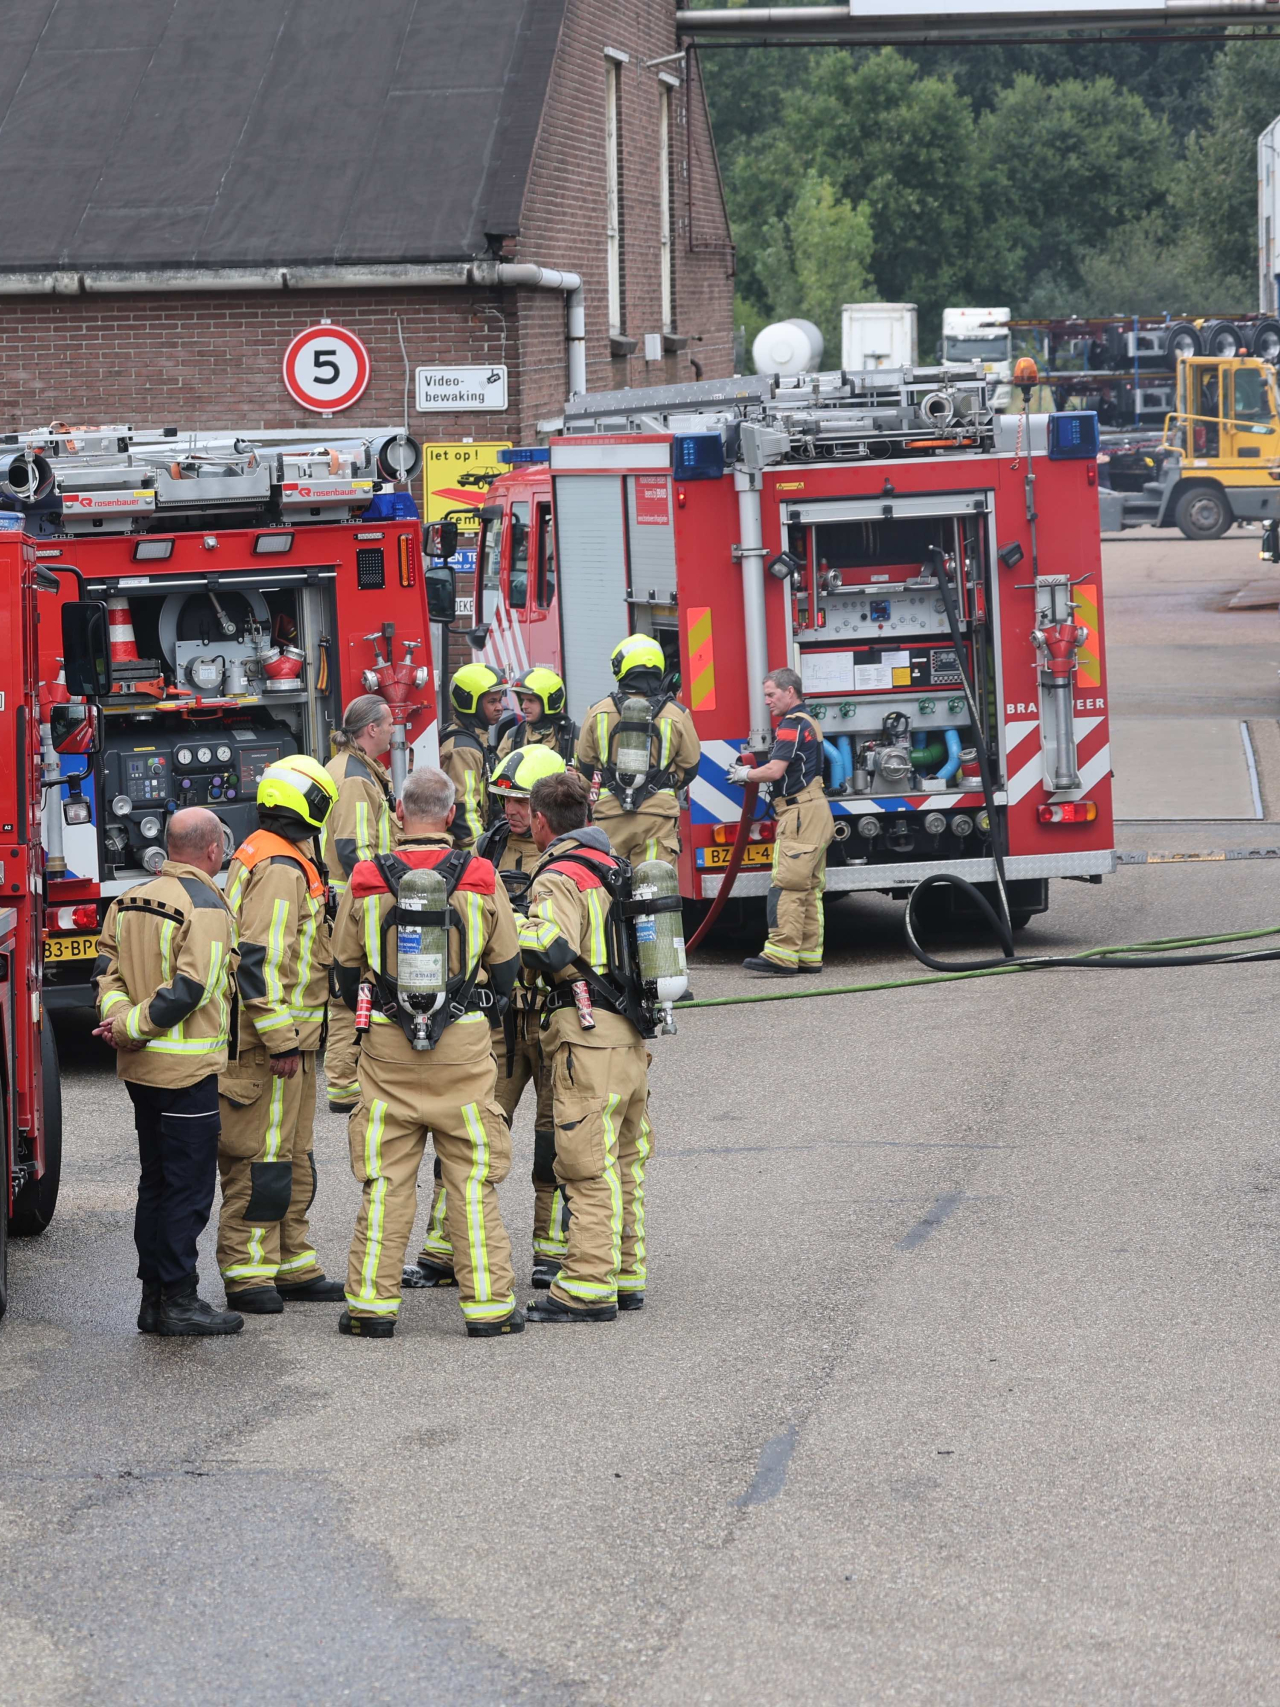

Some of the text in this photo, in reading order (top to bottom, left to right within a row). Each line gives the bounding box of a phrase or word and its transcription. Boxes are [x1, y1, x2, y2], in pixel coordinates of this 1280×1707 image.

[313, 349, 340, 385] 5
[424, 375, 465, 387] Video-
[424, 390, 485, 404] bewaking
[430, 450, 449, 461] let
[313, 488, 358, 497] rosenbauer
[94, 498, 140, 508] rosenbauer
